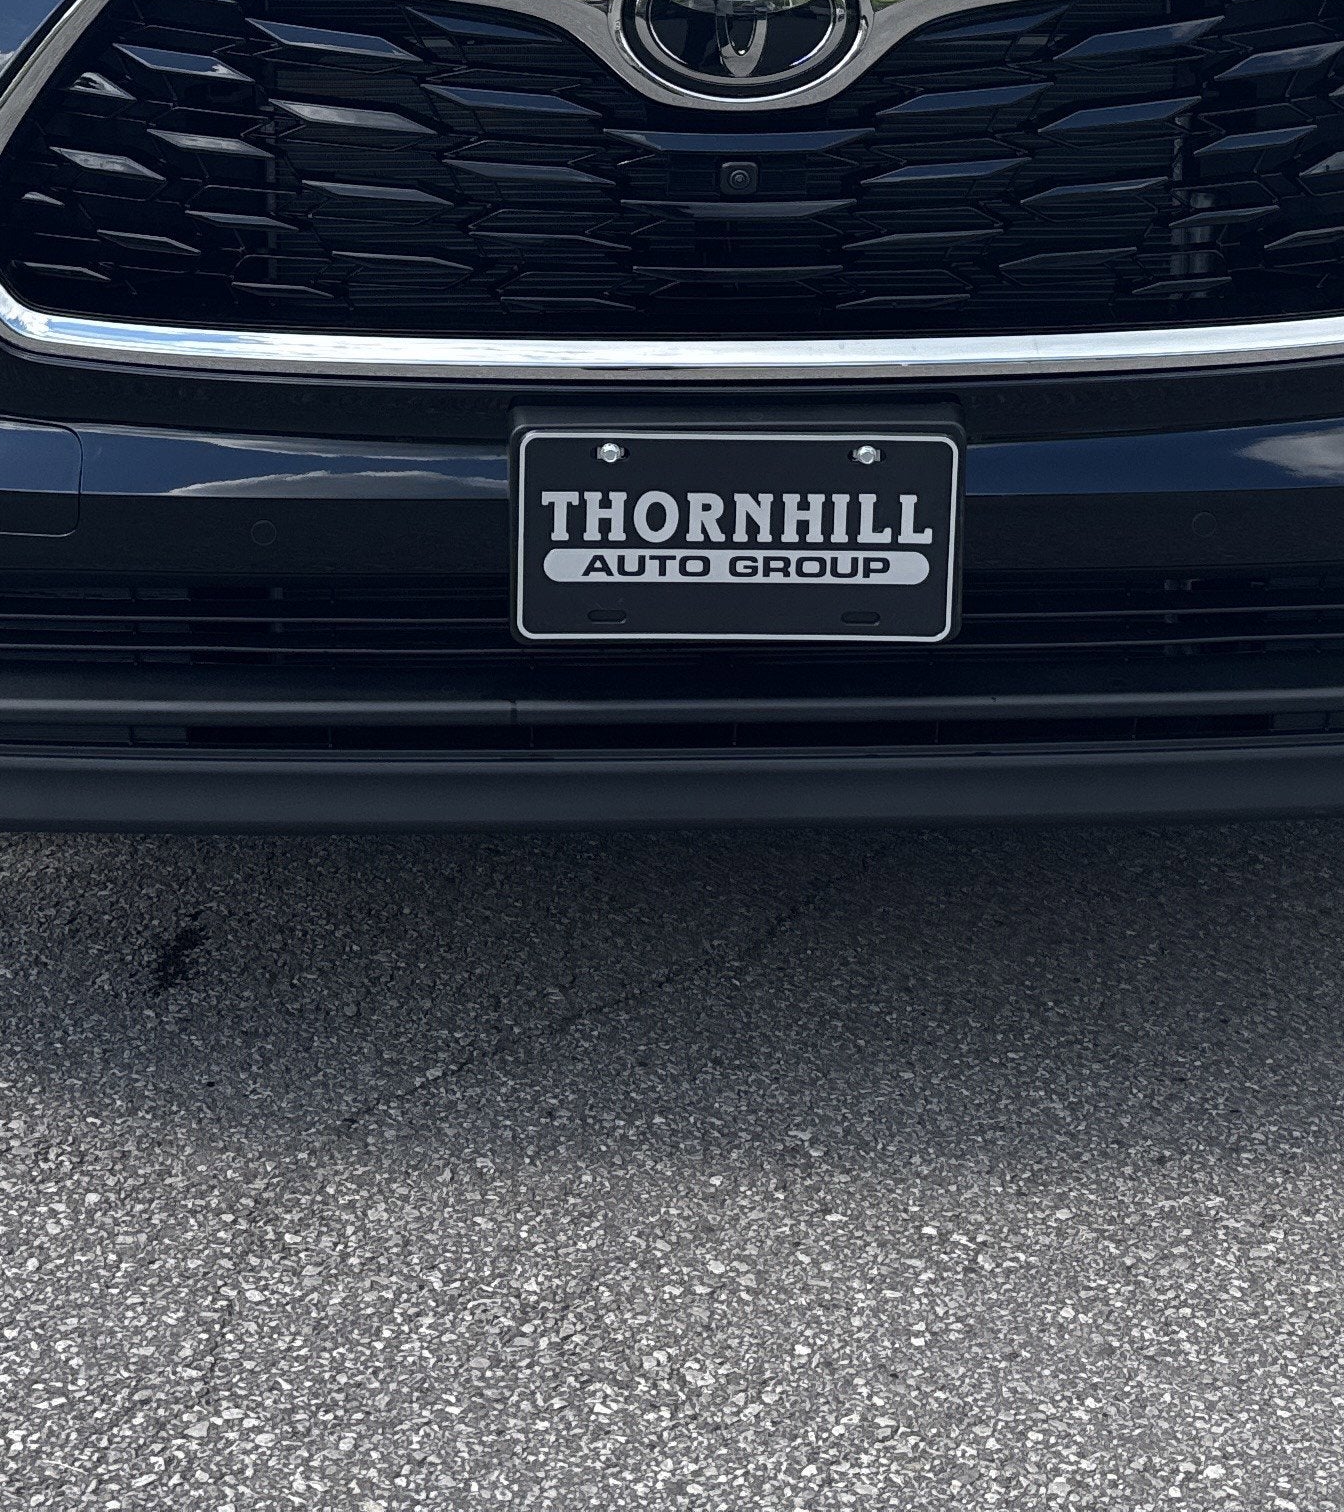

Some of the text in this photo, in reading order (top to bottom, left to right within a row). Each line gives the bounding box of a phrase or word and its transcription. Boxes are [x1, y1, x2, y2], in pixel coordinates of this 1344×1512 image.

[541, 490, 933, 545] THORNHILL
[581, 554, 891, 579] AUTO GROUP
